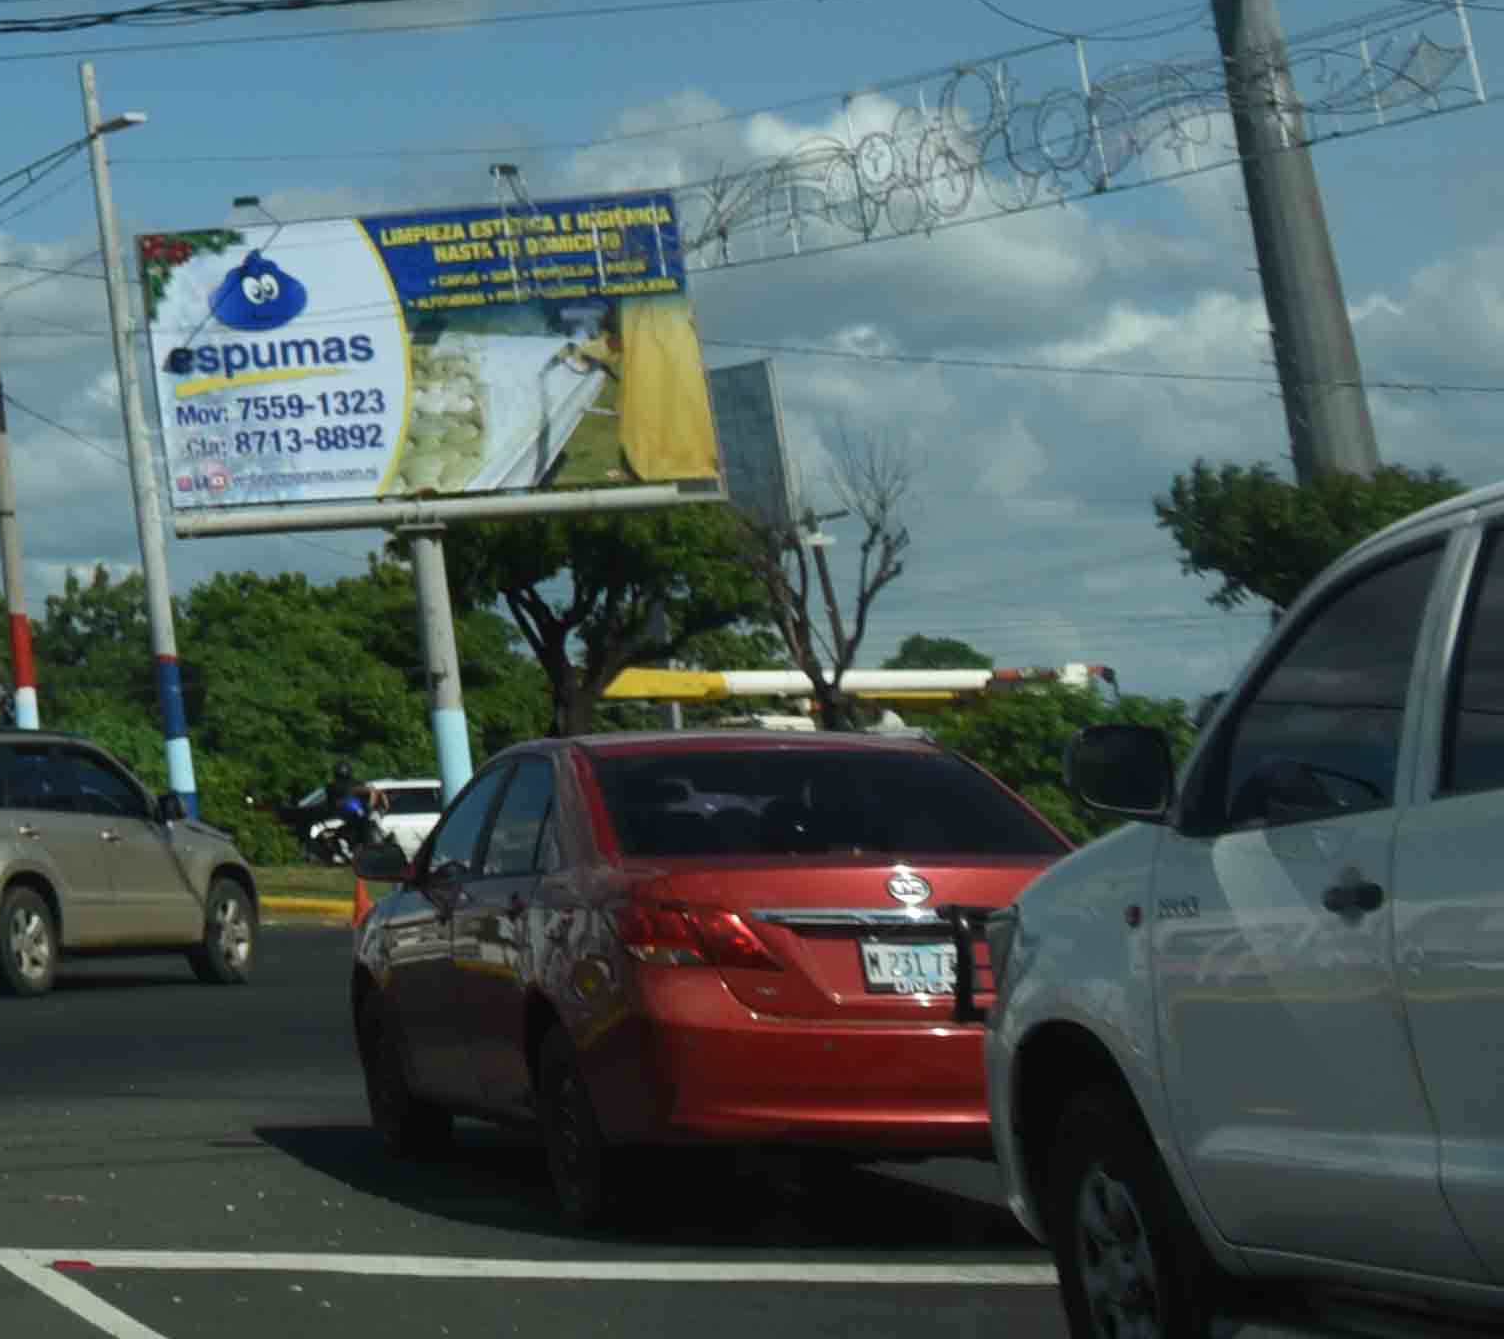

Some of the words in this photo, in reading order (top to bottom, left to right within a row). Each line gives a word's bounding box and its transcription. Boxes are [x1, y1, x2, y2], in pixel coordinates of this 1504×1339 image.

[380, 223, 465, 246] LIMPIEZA
[433, 243, 494, 263] HASTA
[170, 334, 374, 378] espumas
[176, 405, 229, 425] Mov:
[237, 388, 386, 422] 7559-1323
[235, 424, 384, 454] 8713-8892
